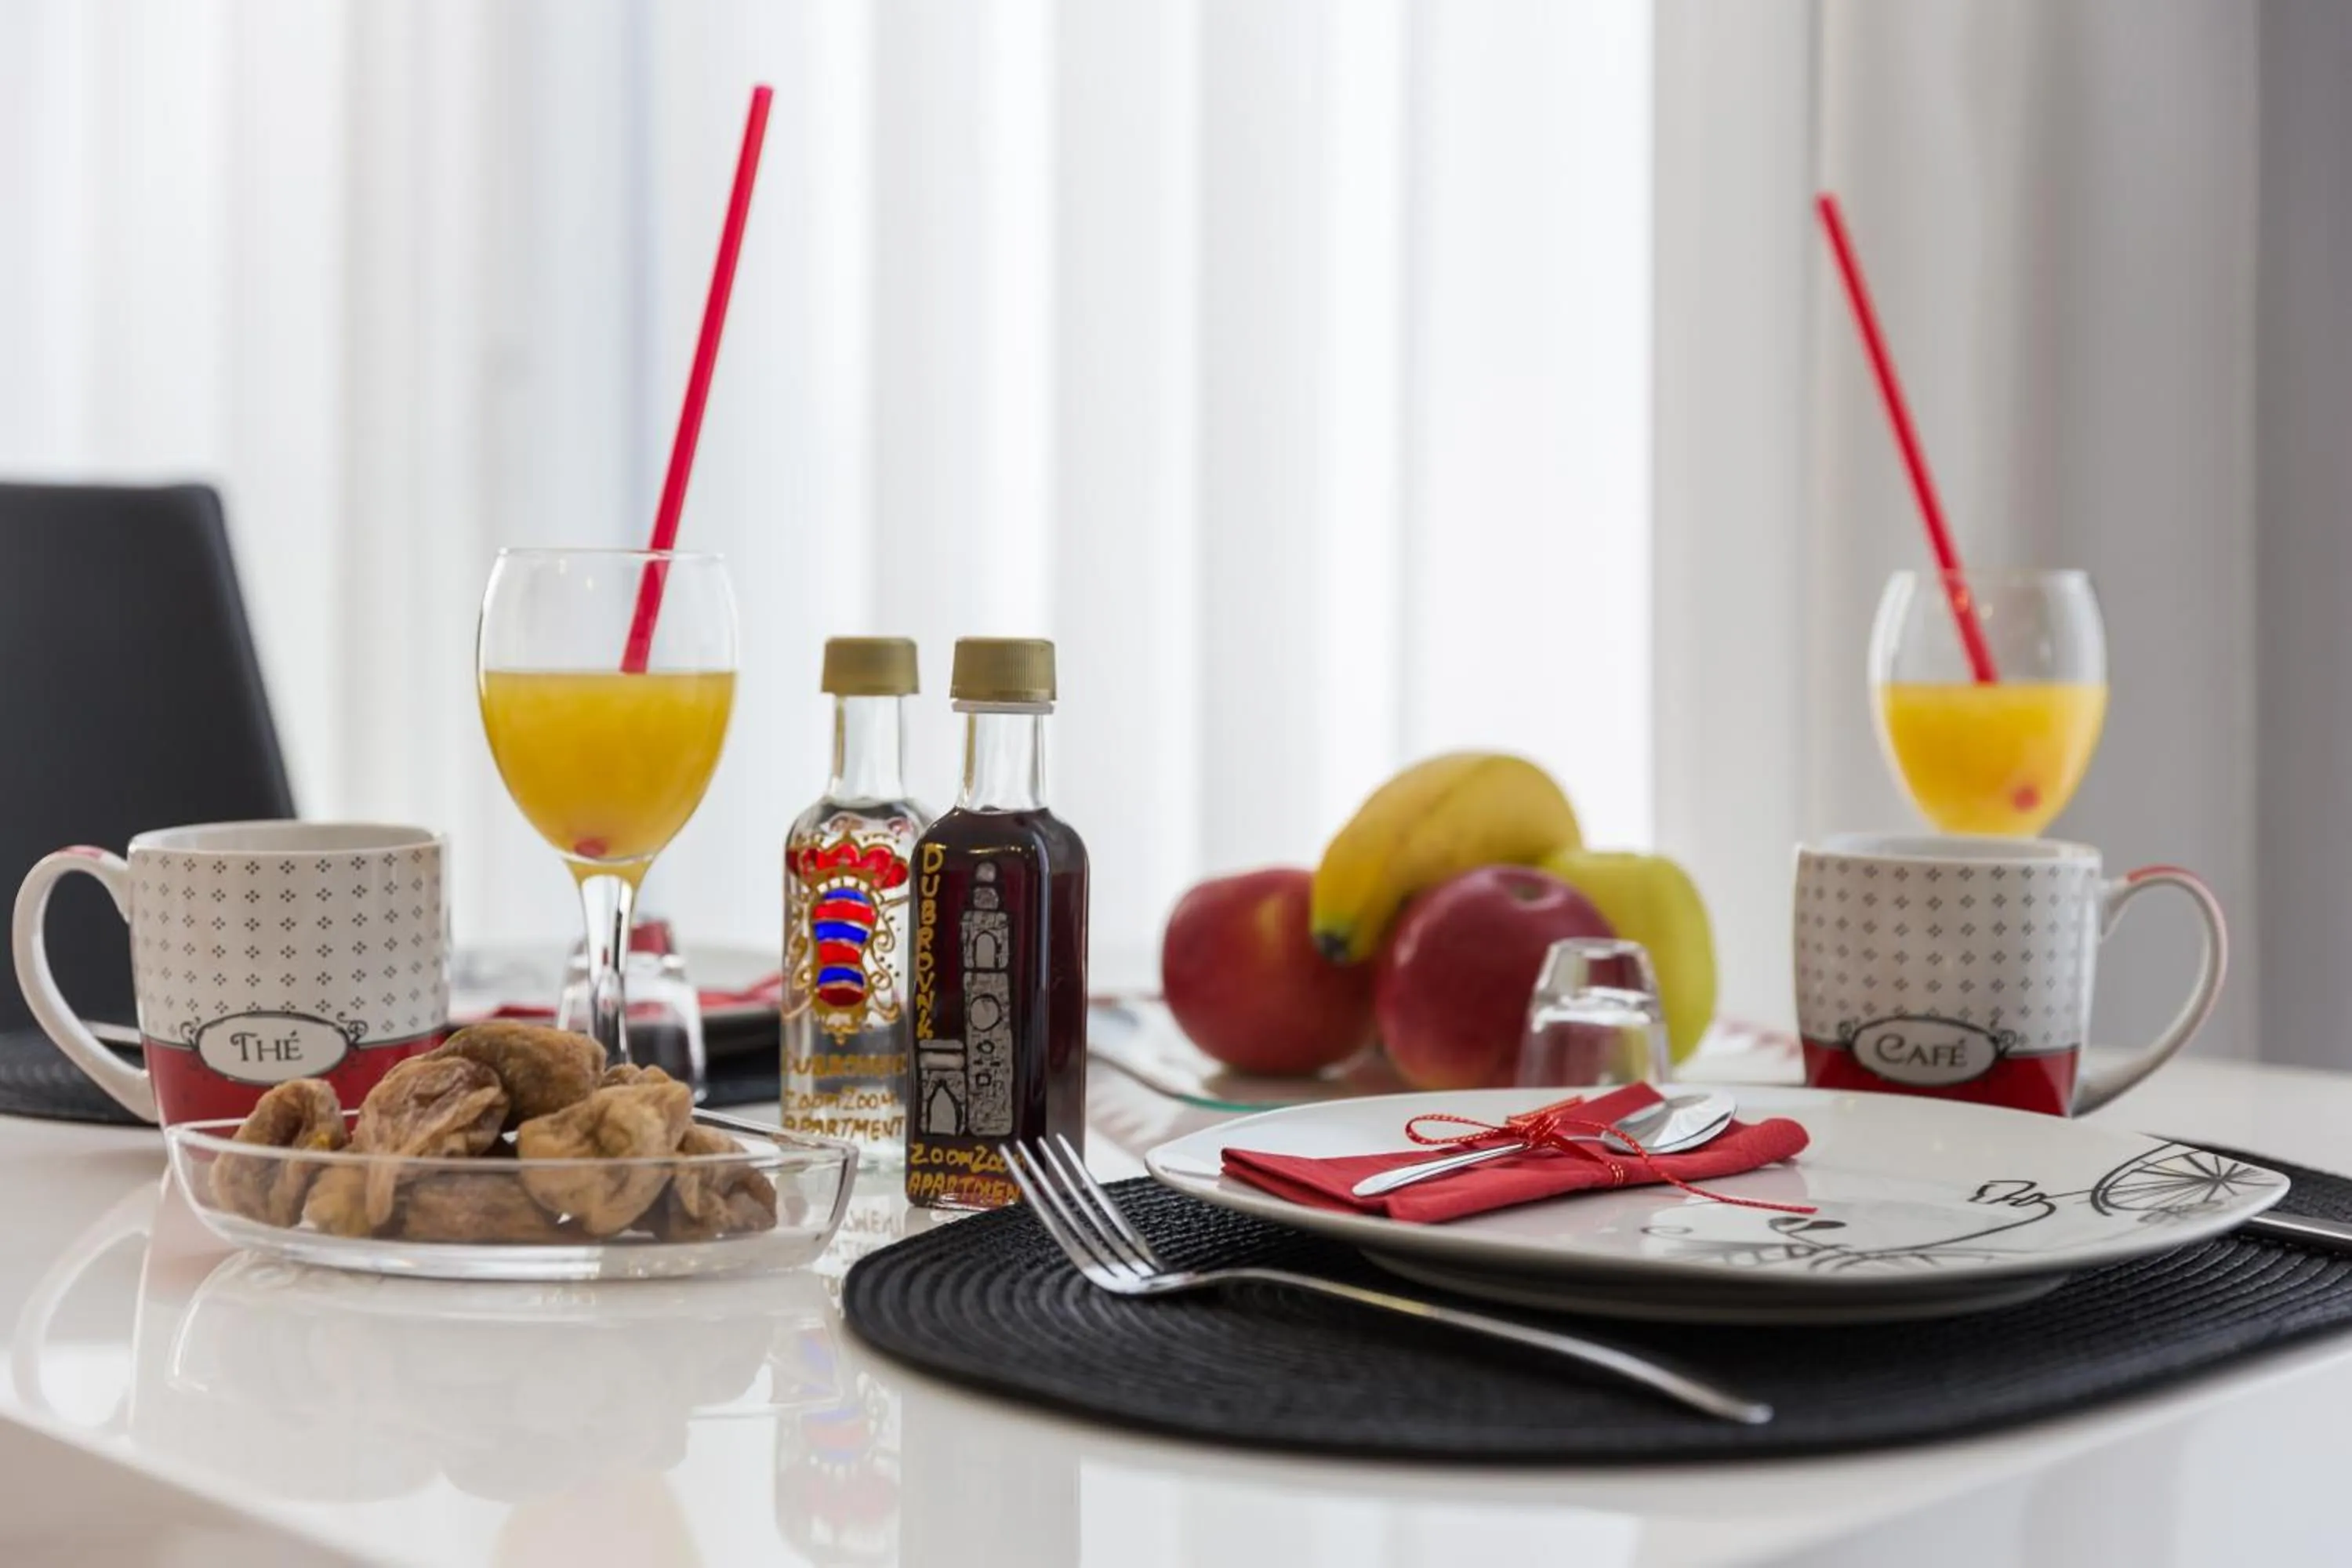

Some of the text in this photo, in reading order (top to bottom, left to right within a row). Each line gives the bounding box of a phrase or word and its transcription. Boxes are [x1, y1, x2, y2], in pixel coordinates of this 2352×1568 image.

[229, 1029, 304, 1062] THÉ
[1874, 1033, 1969, 1067] CAFÉ
[907, 1171, 1024, 1206] APARTMEN
